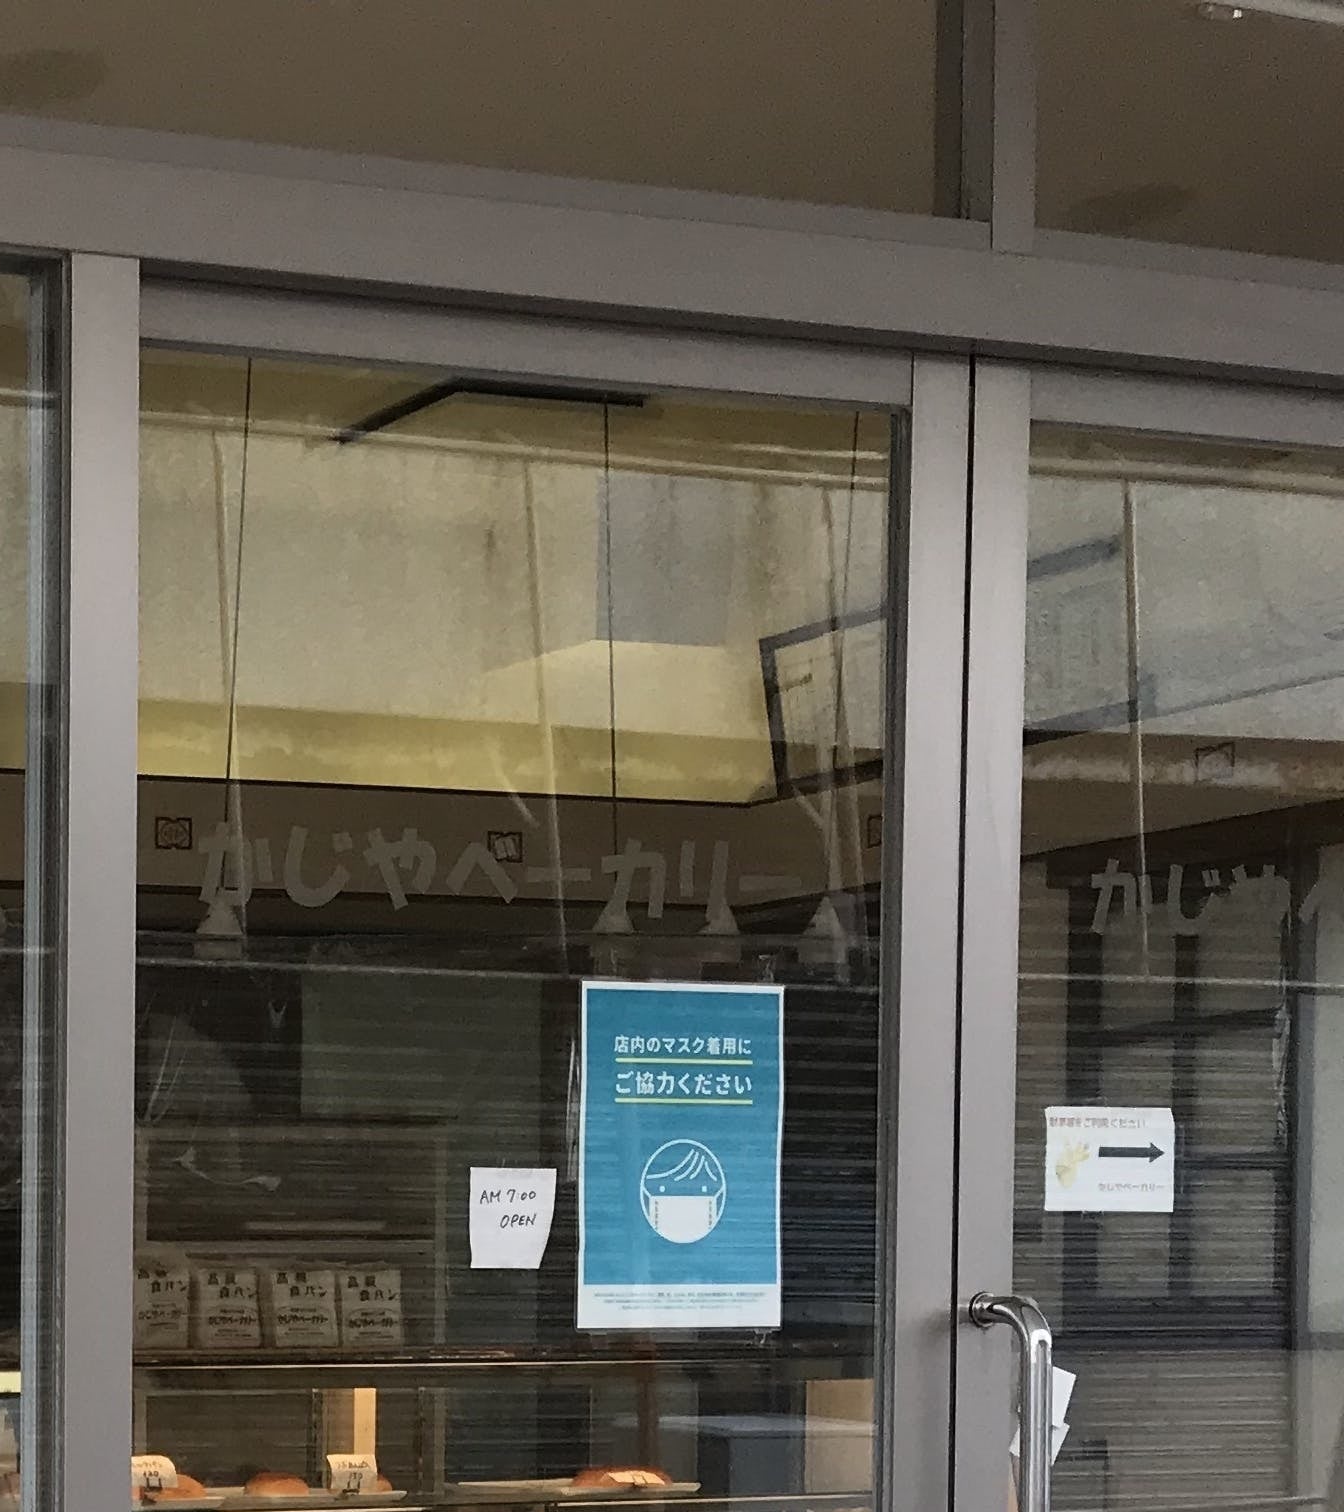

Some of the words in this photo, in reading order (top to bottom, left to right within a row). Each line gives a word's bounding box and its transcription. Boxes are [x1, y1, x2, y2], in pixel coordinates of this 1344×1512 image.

[197, 820, 802, 920] かじやベーカリー
[614, 1034, 752, 1056] 店内のマスク着用に
[615, 1071, 753, 1096] ご協力ください
[480, 1190, 501, 1204] AM
[499, 1213, 537, 1229] OPEN
